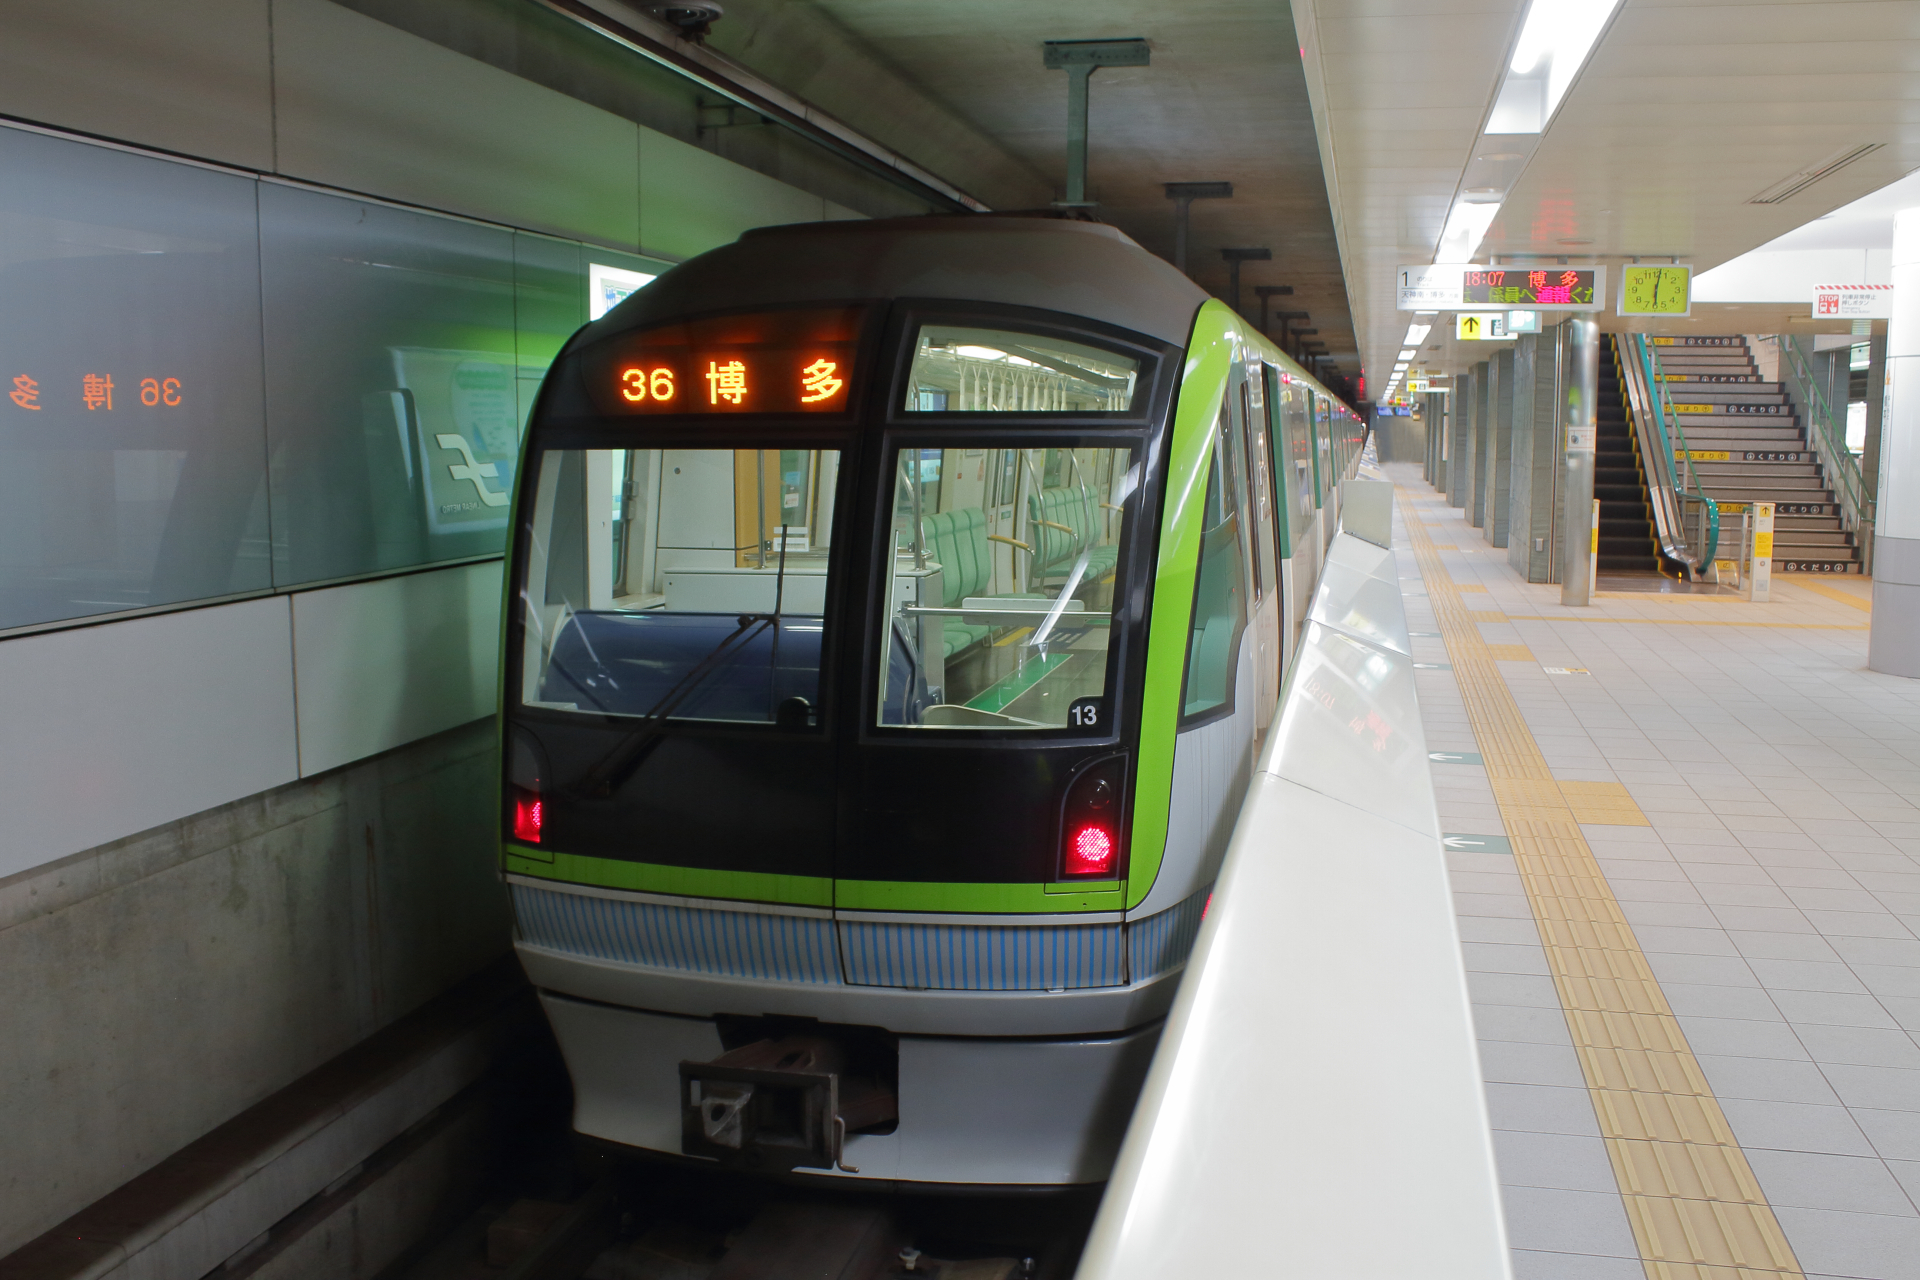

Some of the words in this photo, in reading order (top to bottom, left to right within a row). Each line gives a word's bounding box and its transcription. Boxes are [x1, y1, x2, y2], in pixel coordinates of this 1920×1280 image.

[1401, 271, 1408, 287] 1
[1465, 271, 1505, 286] 18:07
[622, 368, 674, 401] 36
[705, 358, 843, 404] 博多
[1740, 405, 1766, 413] くだり
[1758, 453, 1785, 461] くだり
[1779, 505, 1807, 513] くだり
[1800, 563, 1830, 571] くだり
[1072, 705, 1097, 725] 13
